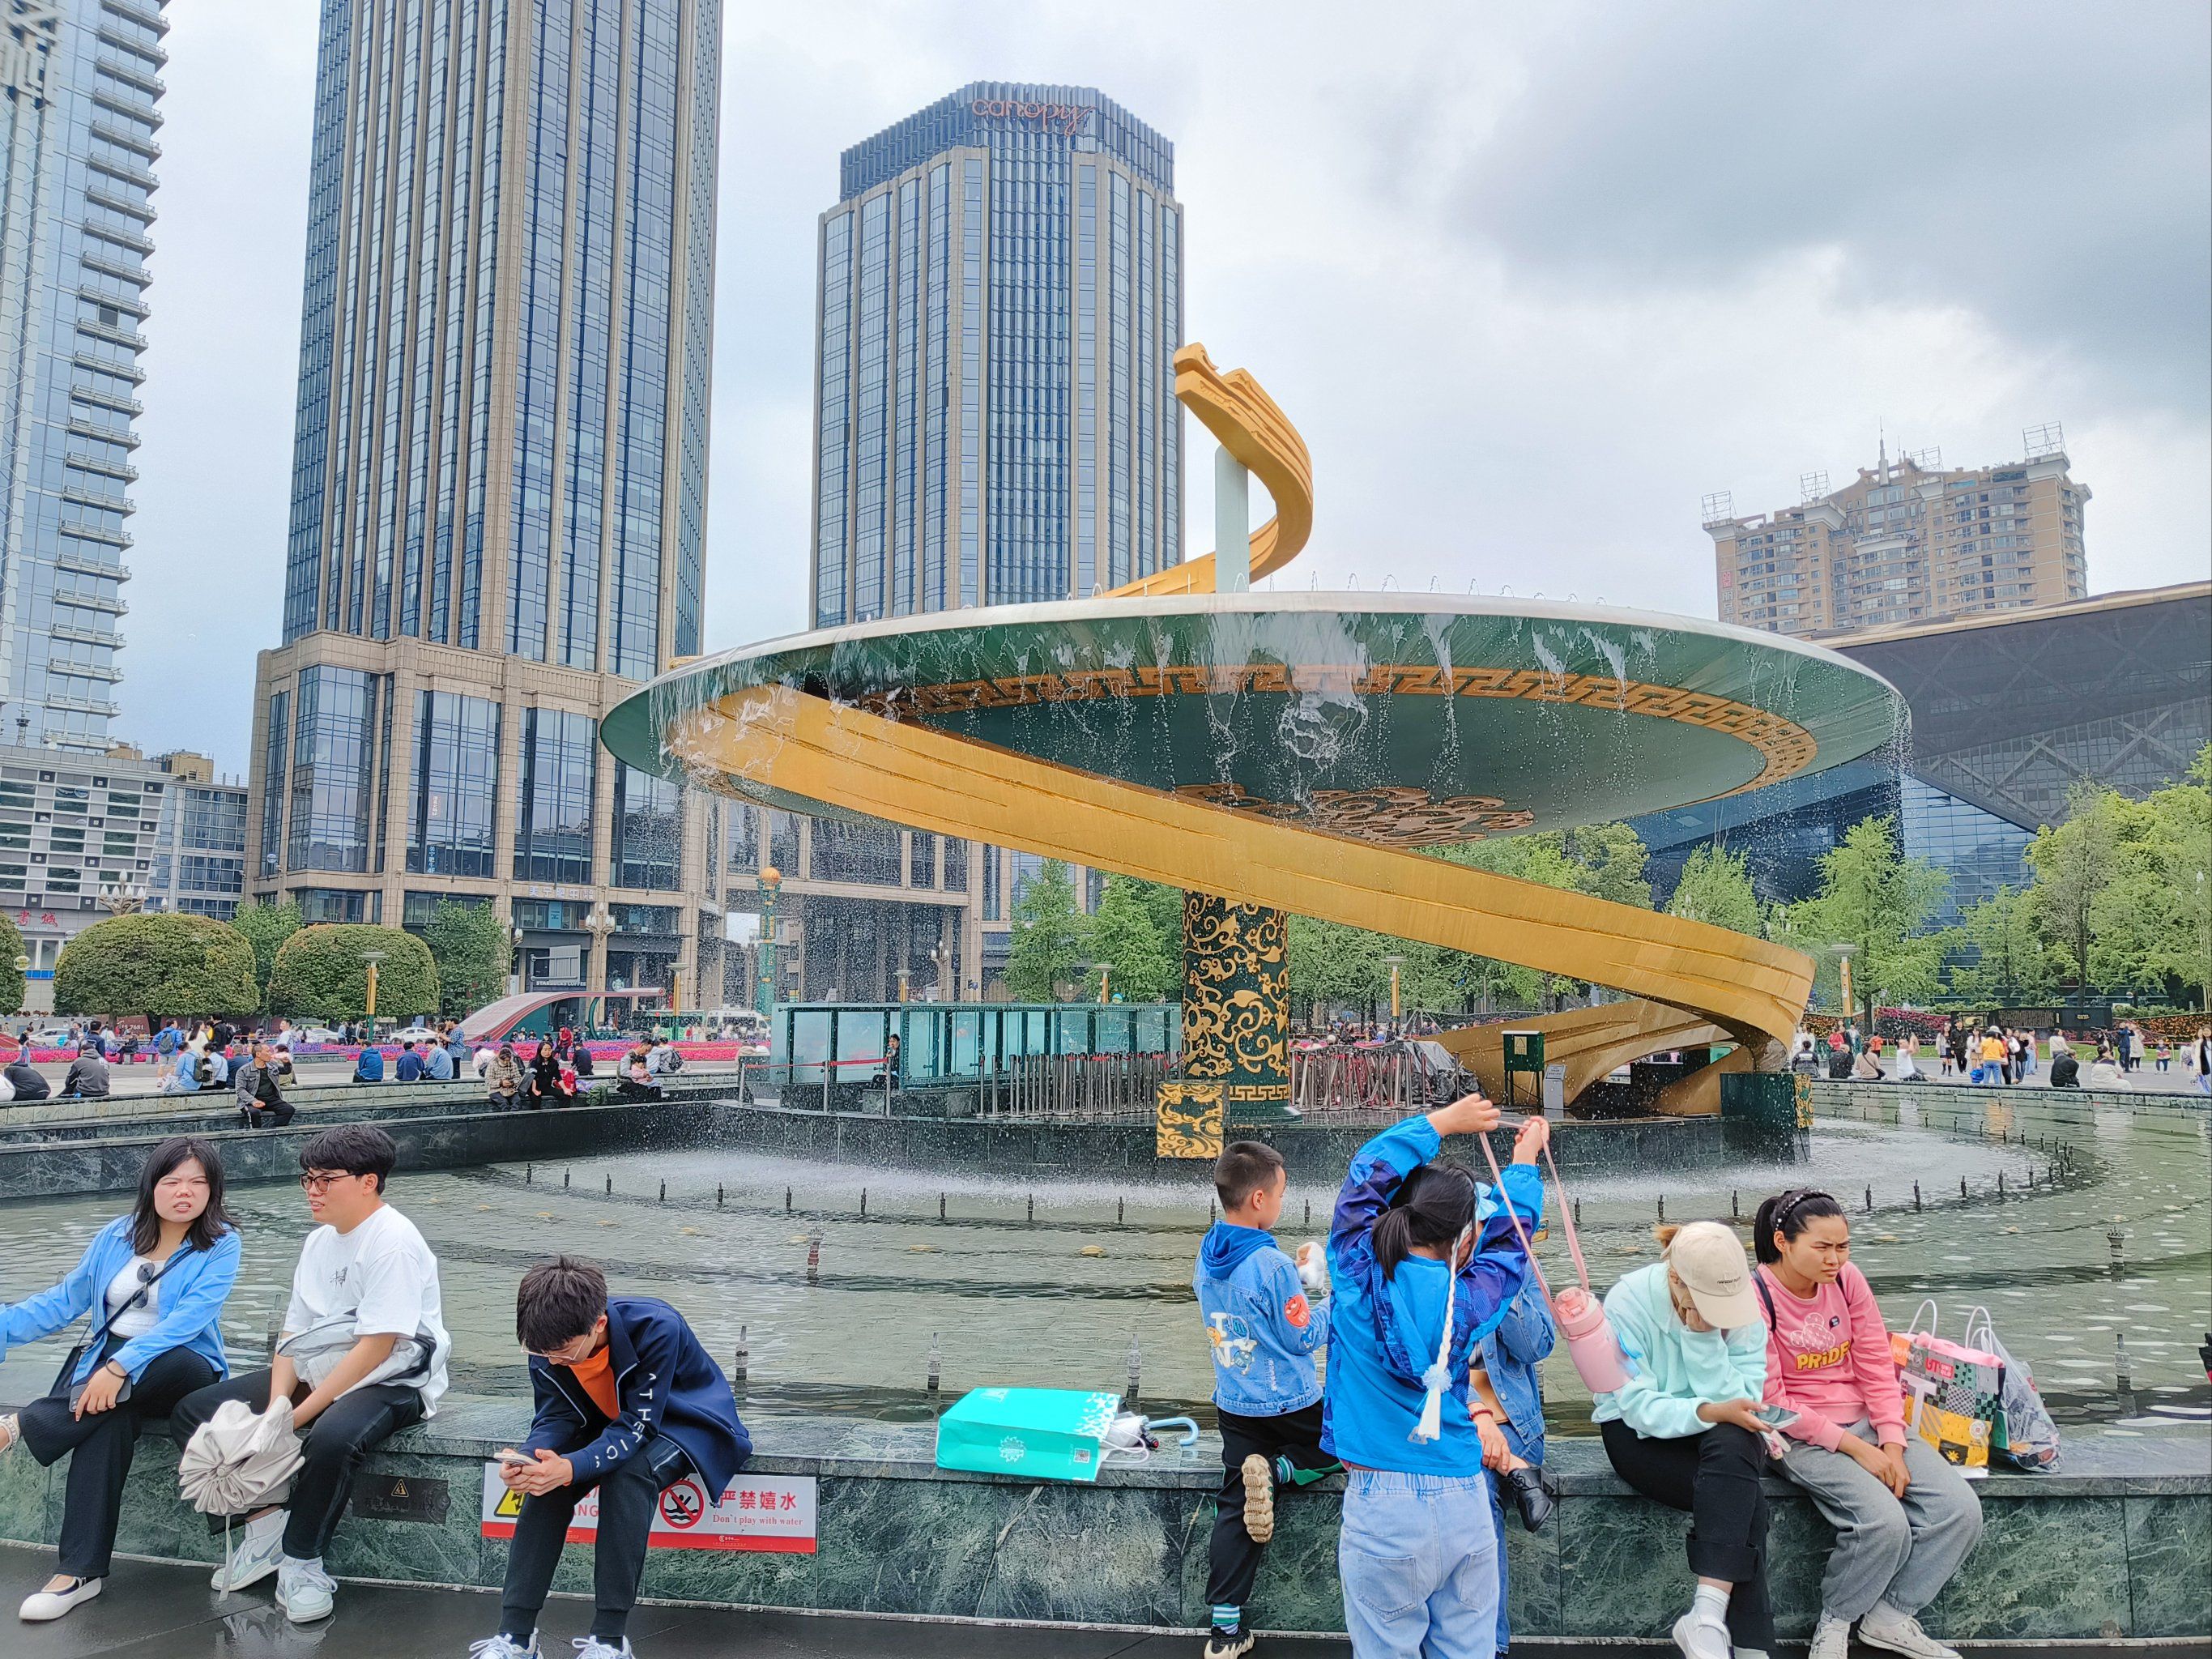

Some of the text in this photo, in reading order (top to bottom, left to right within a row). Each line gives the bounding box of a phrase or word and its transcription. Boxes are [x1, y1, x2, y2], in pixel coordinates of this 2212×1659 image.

[972, 99, 1096, 136] canopy
[720, 1491, 796, 1511] 严禁嬉水
[739, 1516, 757, 1525] play
